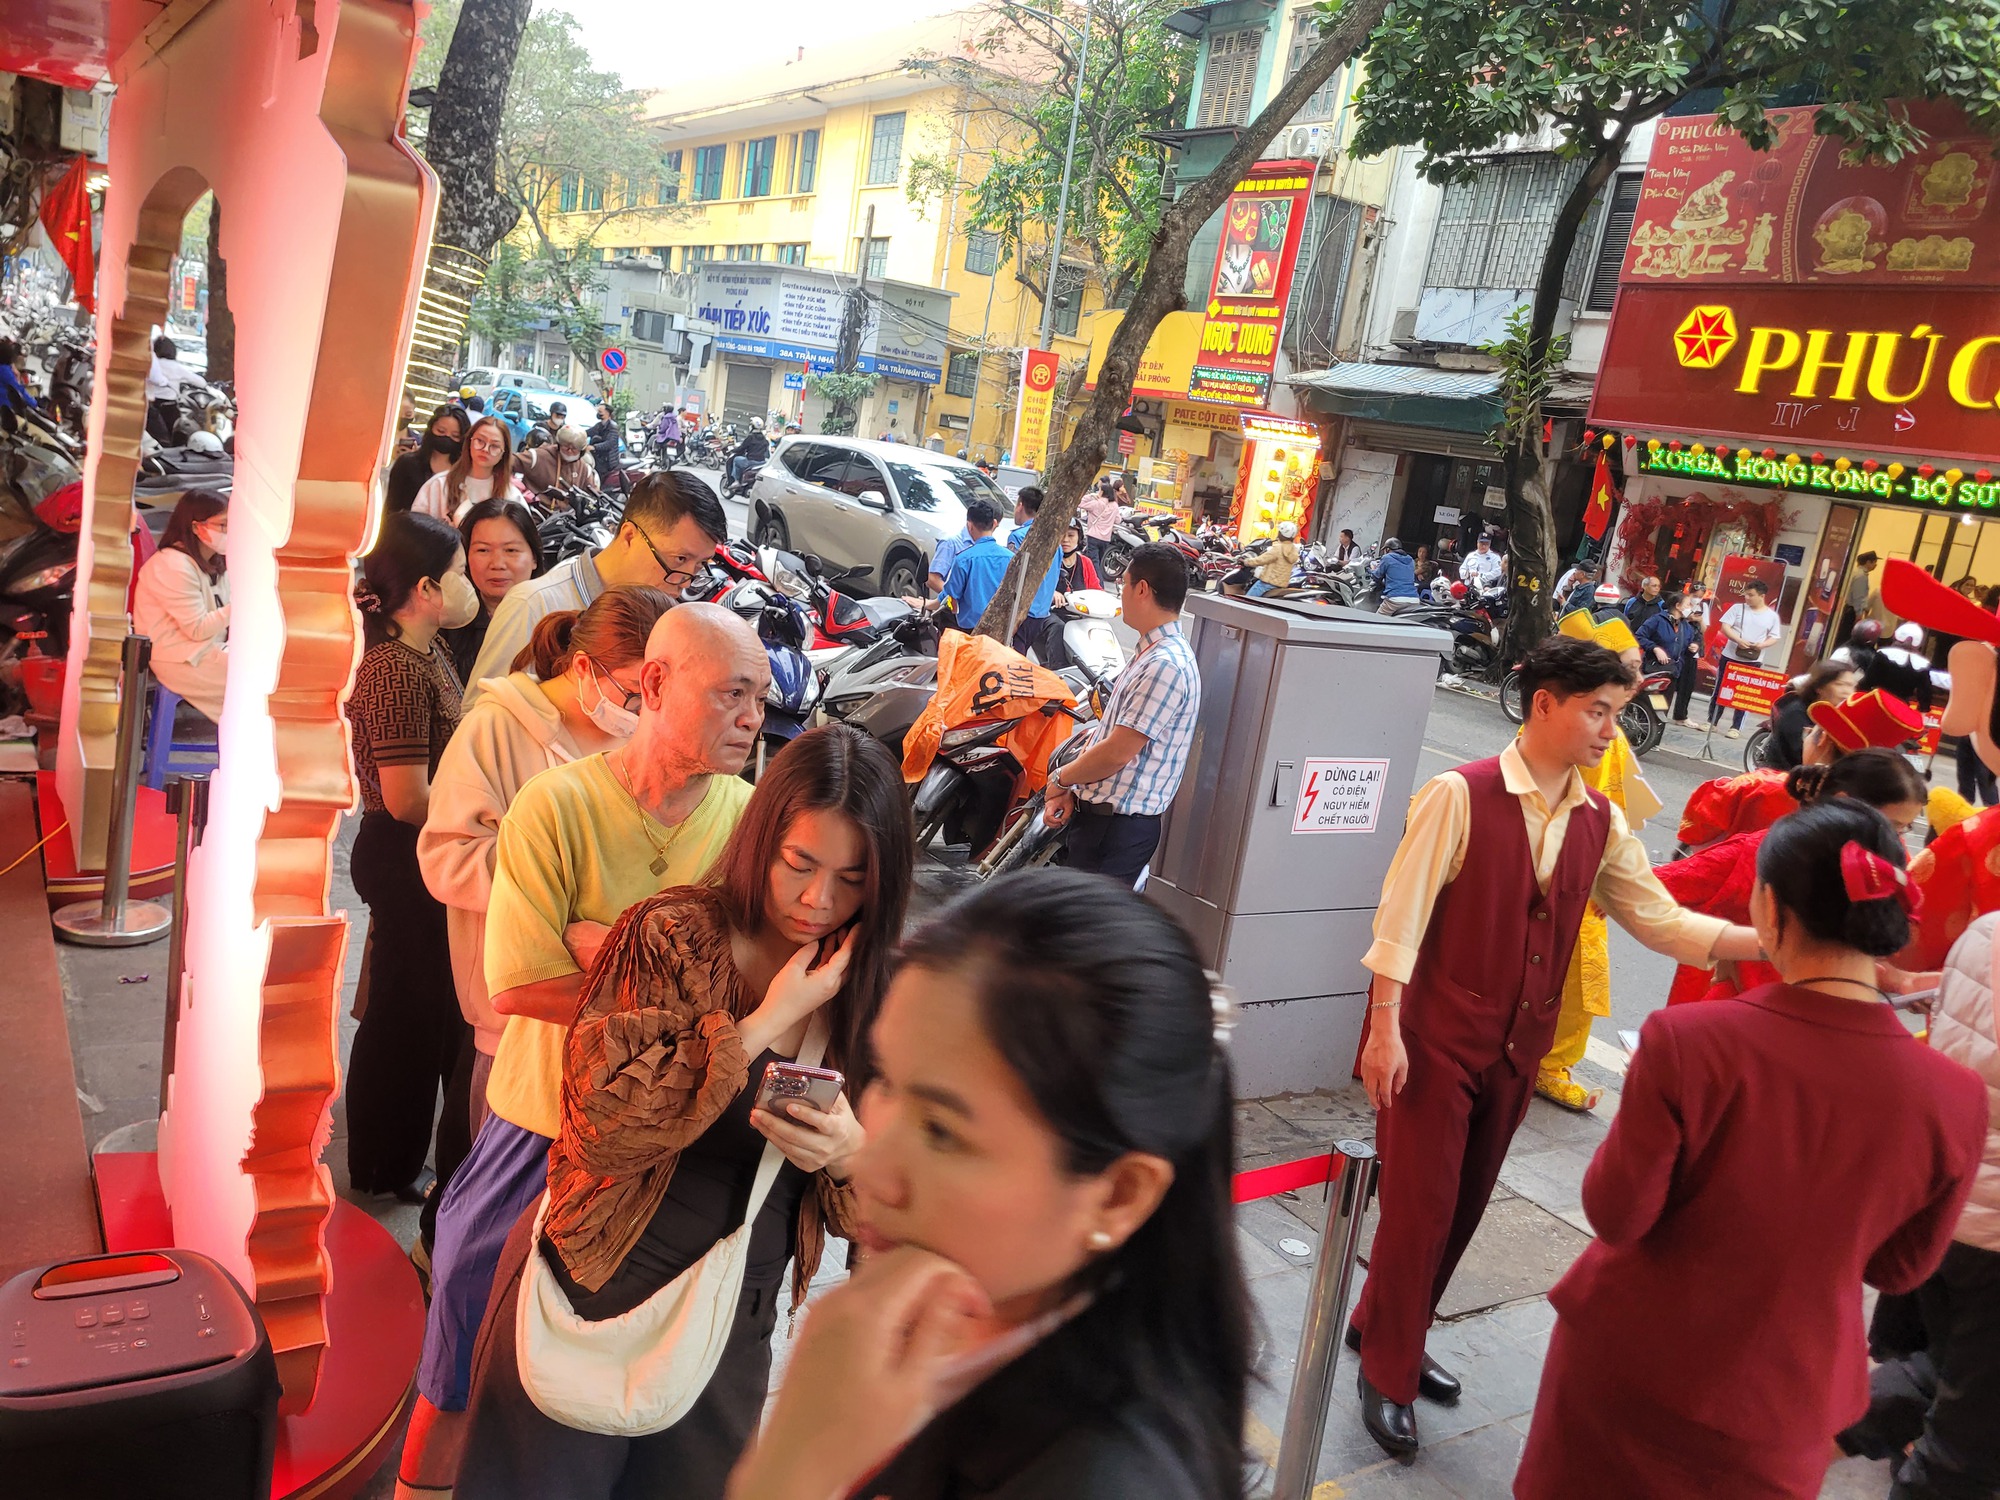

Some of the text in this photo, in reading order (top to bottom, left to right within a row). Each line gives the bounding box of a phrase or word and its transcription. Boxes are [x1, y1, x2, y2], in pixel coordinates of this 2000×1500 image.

[1670, 123, 1703, 140] PHÚ
[724, 300, 746, 331] TIẾP
[747, 306, 771, 334] XÚC
[1201, 321, 1277, 356] NGỌC DUNG
[779, 349, 794, 358] 38A
[818, 353, 835, 365] NHÂ
[1733, 323, 1945, 404] PHÚ
[878, 363, 889, 372] 38A
[1147, 374, 1171, 384] PHÒNG
[1174, 408, 1240, 426] PATE CỘT ĐÈN
[1911, 474, 1953, 506] BỘ
[1517, 574, 1540, 592] 26
[1530, 594, 1539, 607] 6
[1324, 766, 1381, 784] DỪNG LẠI!
[1332, 784, 1367, 798] CÓ ĐIỆN
[1322, 797, 1370, 810] NGUY HIỂM
[1318, 812, 1370, 825] CHẾT NGƯỜI
